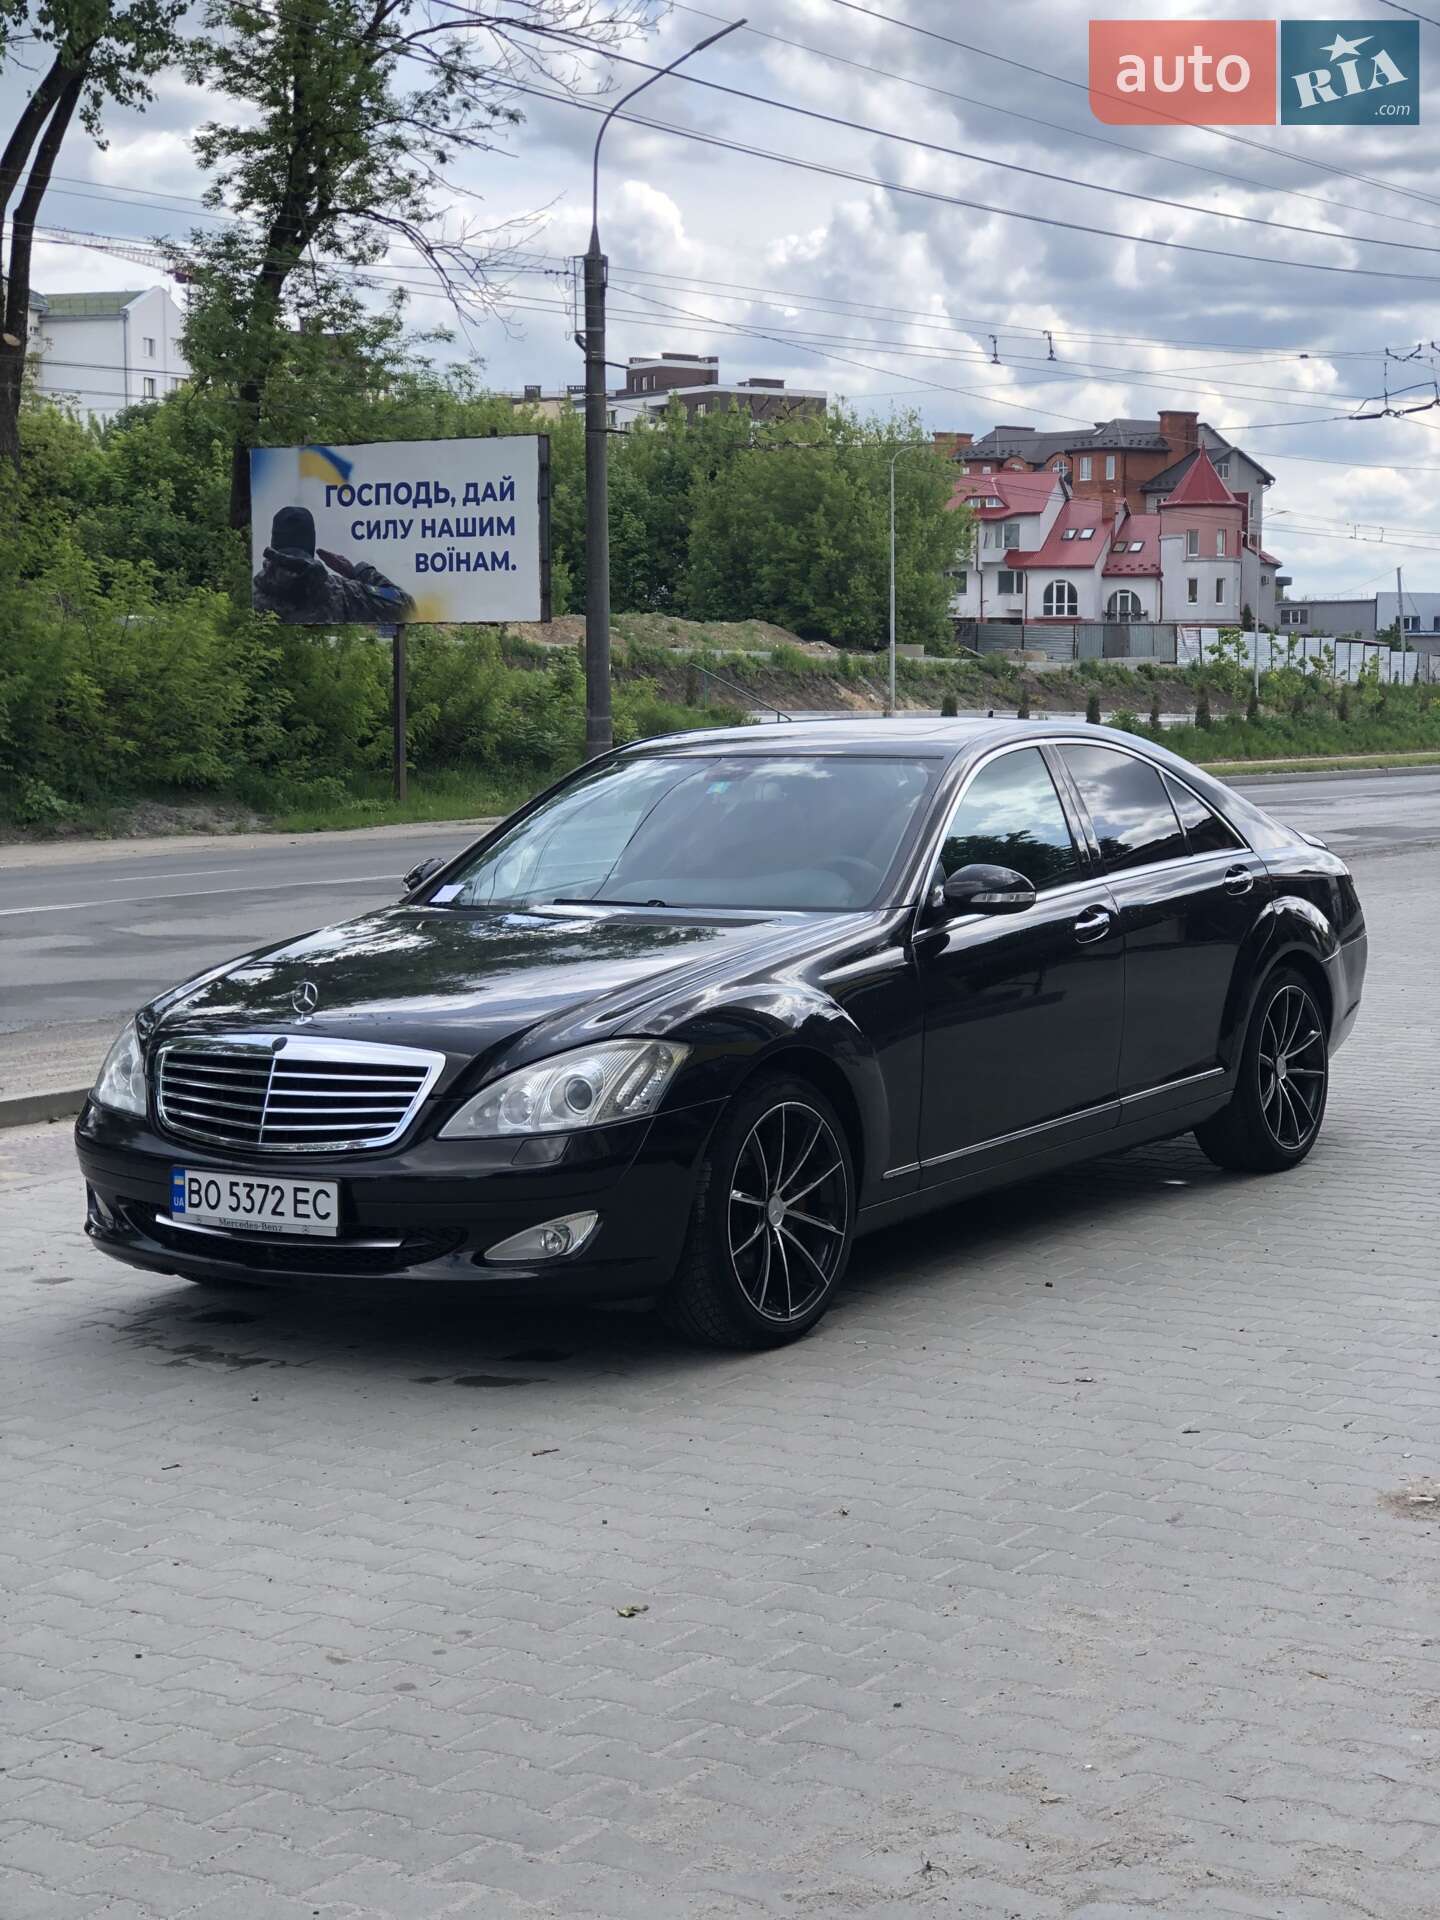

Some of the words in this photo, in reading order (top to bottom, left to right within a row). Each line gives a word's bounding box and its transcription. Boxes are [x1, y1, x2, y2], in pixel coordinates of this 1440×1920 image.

[325, 481, 456, 509] ГОСПОДЬ,
[462, 475, 516, 507] ДАЙ
[351, 519, 414, 541] СИЛУ
[421, 516, 516, 539] НАШИМ
[415, 546, 517, 573] ВОЇНАМ.
[173, 1196, 184, 1207] UA
[187, 1177, 221, 1210] BO
[228, 1180, 285, 1217] 5372
[293, 1187, 331, 1220] EC
[219, 1216, 283, 1232] Mercedes-Benz
